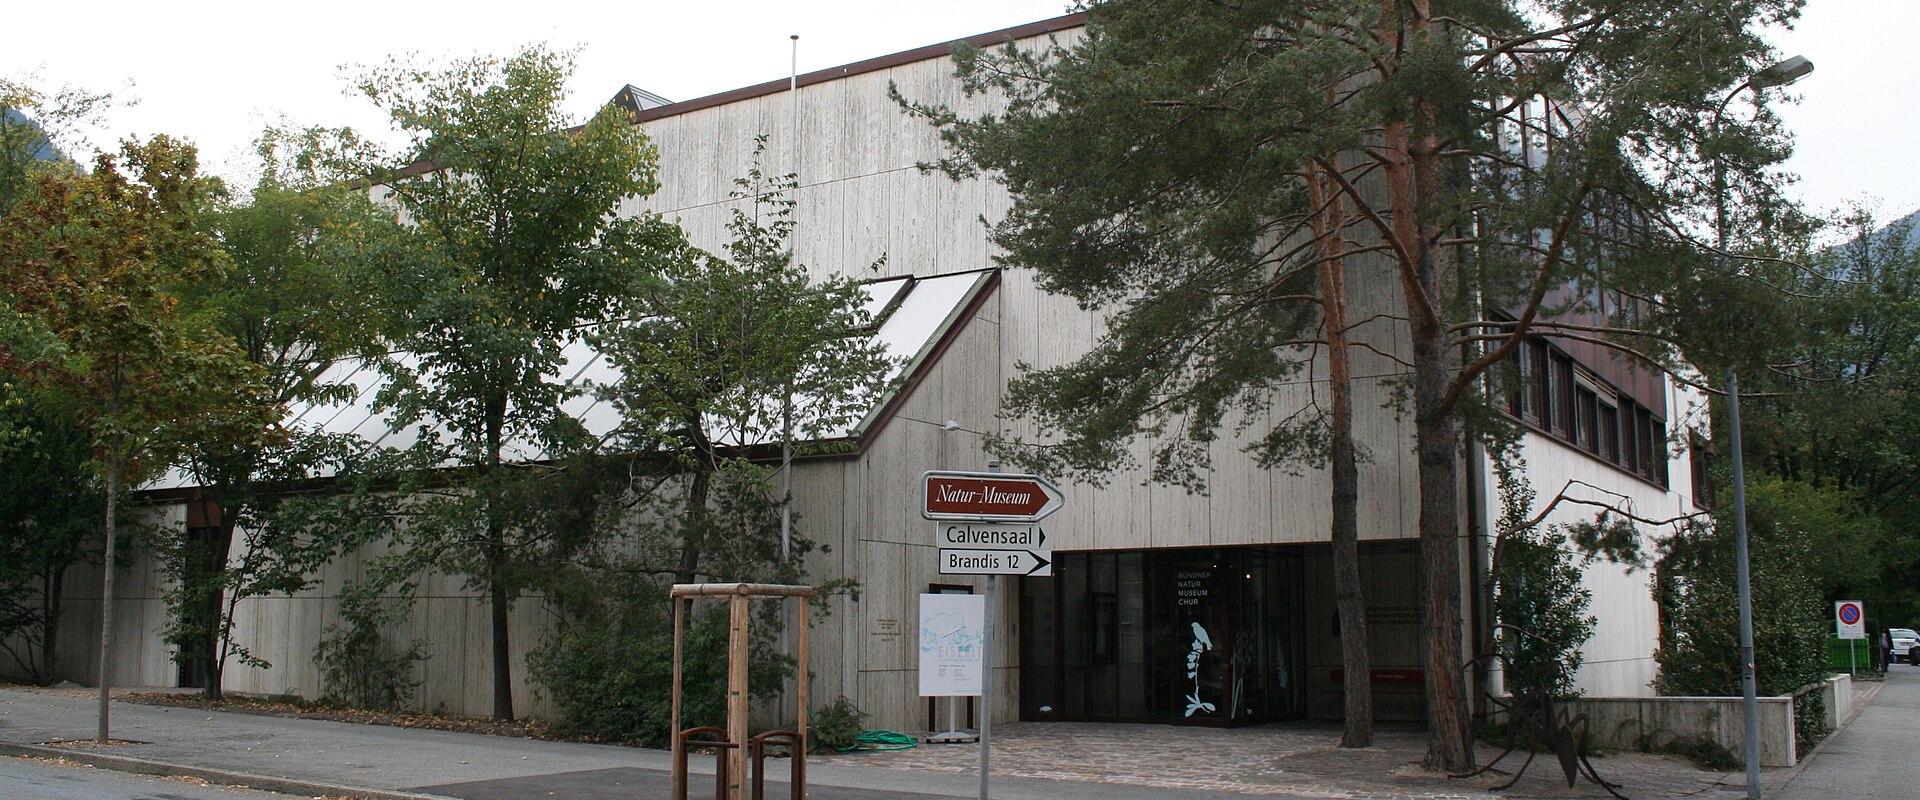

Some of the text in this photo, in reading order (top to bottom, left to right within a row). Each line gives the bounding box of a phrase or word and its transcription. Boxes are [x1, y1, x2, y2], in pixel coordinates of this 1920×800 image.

[936, 484, 1031, 505] Natur-Museum
[946, 526, 1032, 544] Calvensaal
[949, 554, 1019, 568] Brandis 12
[1177, 580, 1201, 588] NATUR
[1178, 589, 1208, 597] MUSEUM
[1178, 598, 1199, 606] CHUR
